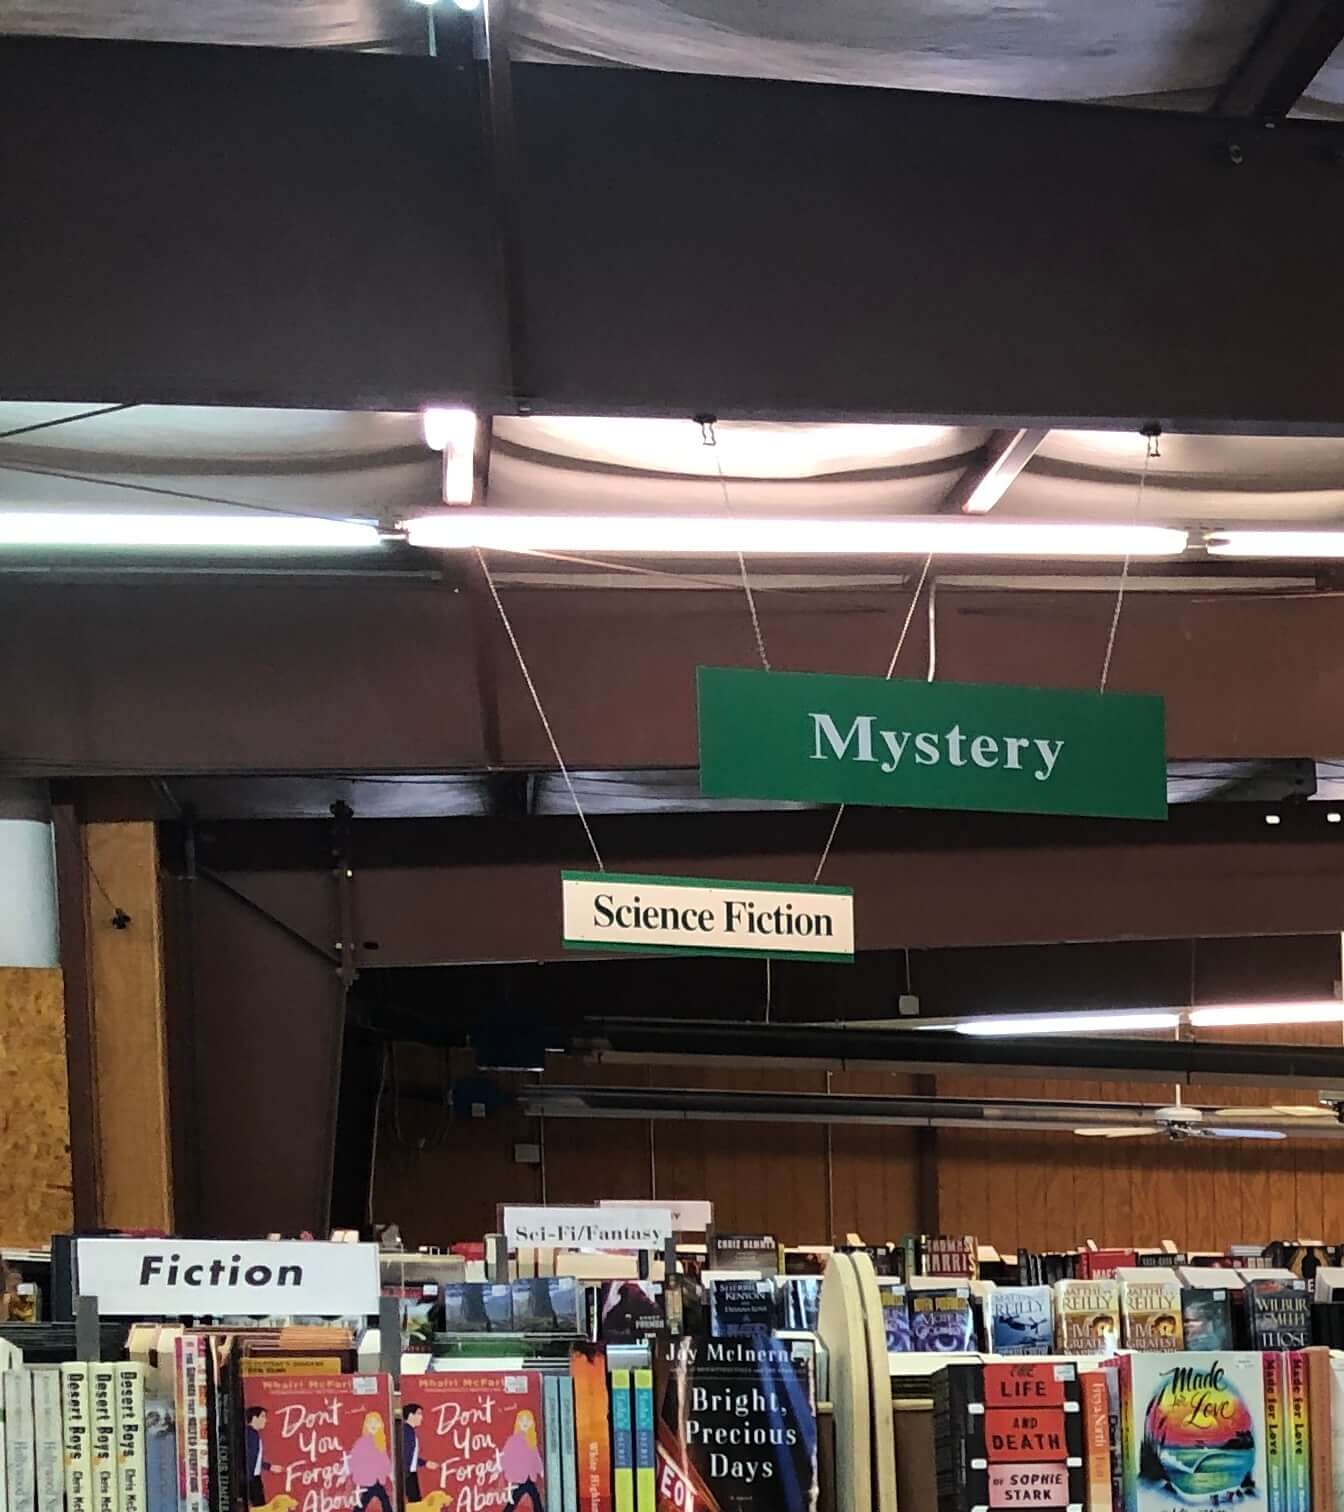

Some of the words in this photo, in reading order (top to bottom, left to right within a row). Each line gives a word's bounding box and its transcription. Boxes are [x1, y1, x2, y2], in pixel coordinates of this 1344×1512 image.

[808, 713, 1064, 780] Mystery
[593, 894, 714, 932] Science
[724, 901, 833, 937] Fiction
[515, 1224, 662, 1248] Sci-Fi/Fantasy
[138, 1255, 305, 1289] Fiction
[691, 1388, 788, 1413] Bright,
[1001, 1380, 1048, 1397] LIFE
[685, 1419, 797, 1446] Precious
[1013, 1417, 1037, 1429] AND
[300, 1430, 343, 1463] You
[992, 1434, 1061, 1451] DEATH
[283, 1455, 352, 1492] Forget
[710, 1453, 773, 1479] Days
[1010, 1472, 1063, 1487] SOPHIE
[1004, 1488, 1052, 1501] STARK
